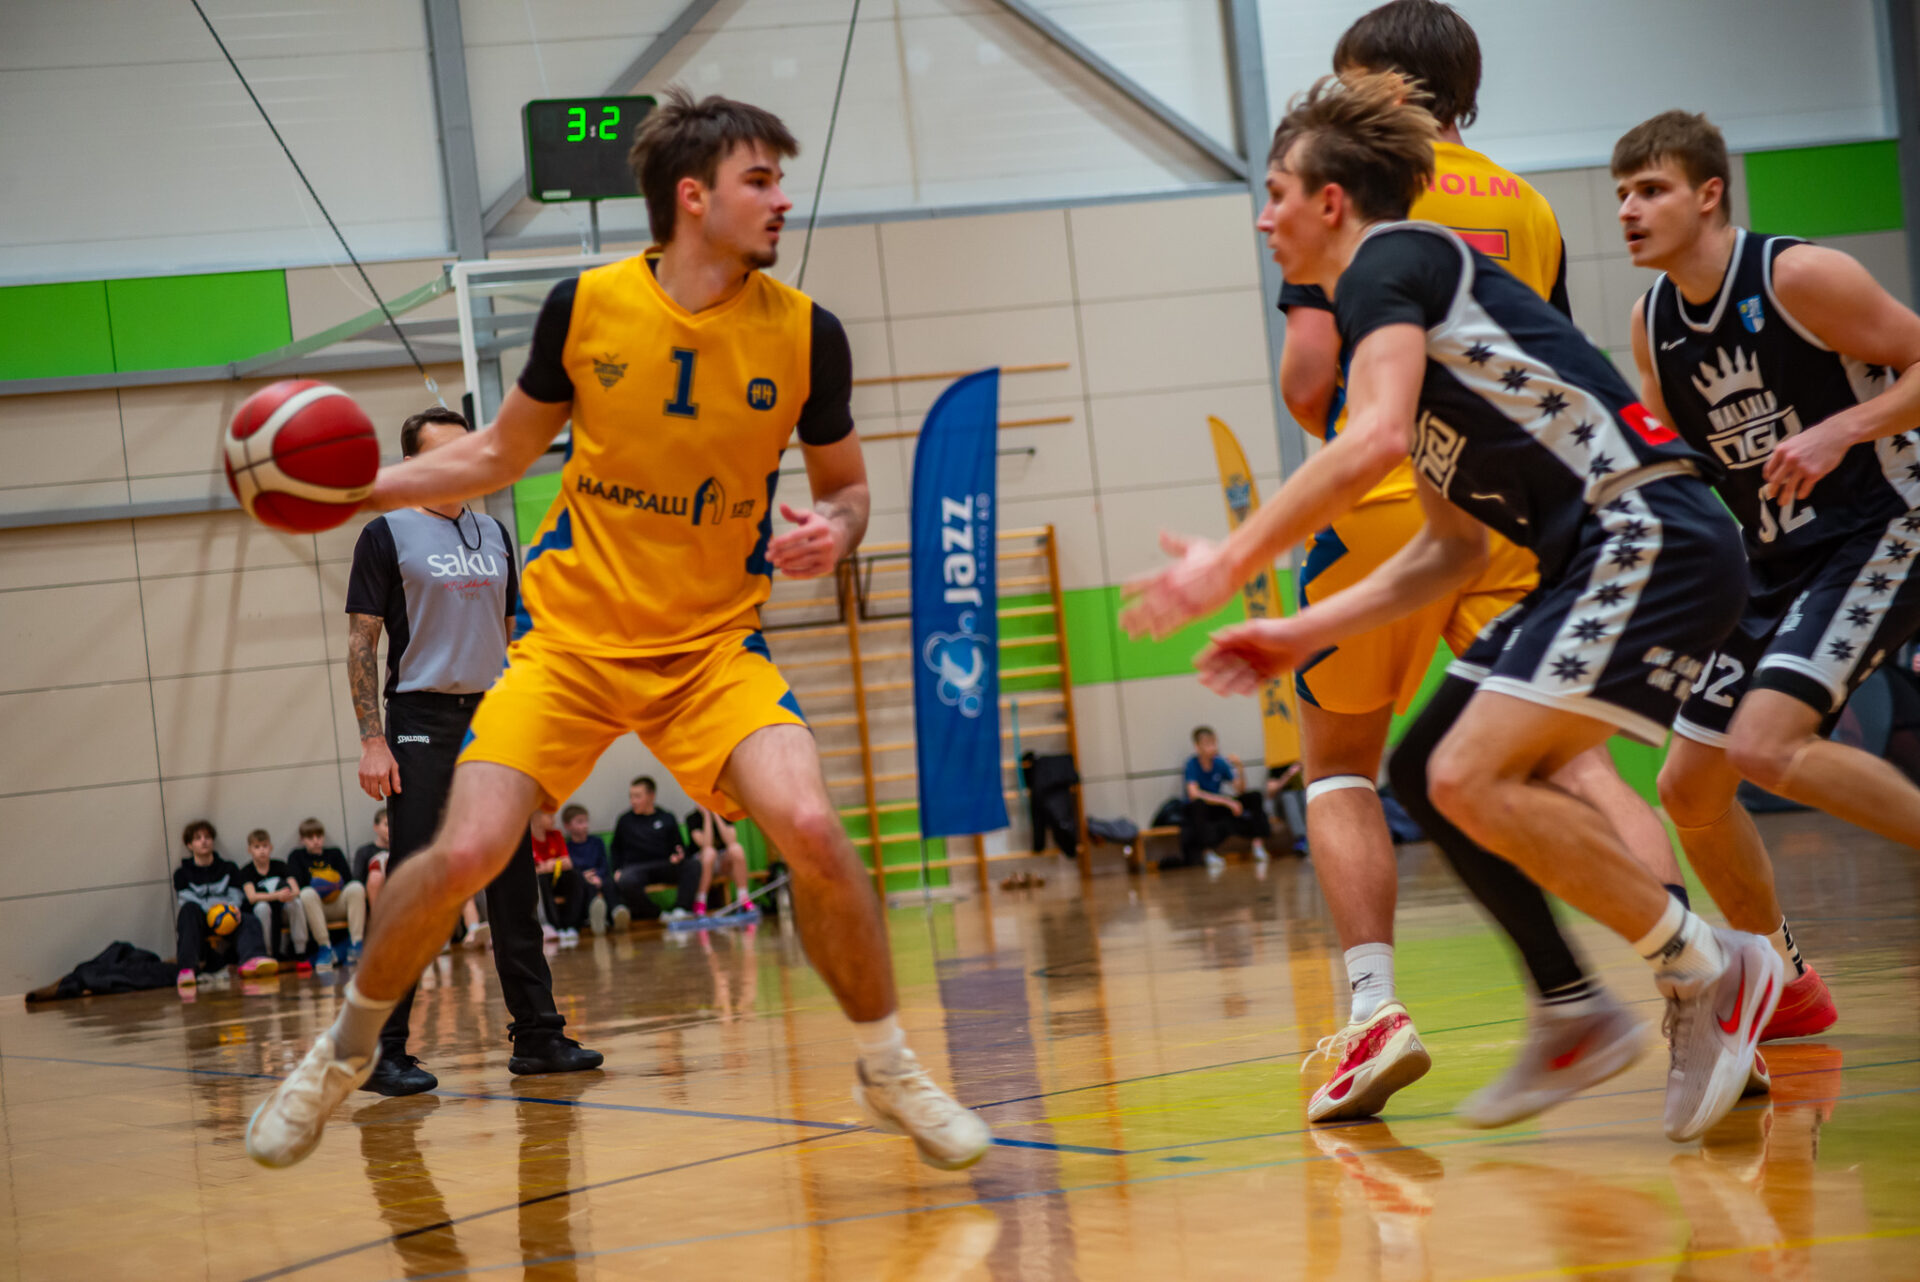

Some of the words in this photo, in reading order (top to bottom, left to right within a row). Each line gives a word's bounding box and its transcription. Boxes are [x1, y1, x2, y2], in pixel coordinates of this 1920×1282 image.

[663, 346, 699, 420] 1
[577, 474, 688, 516] HAAPSALU
[427, 544, 499, 577] saku
[397, 735, 430, 744] SPALDING
